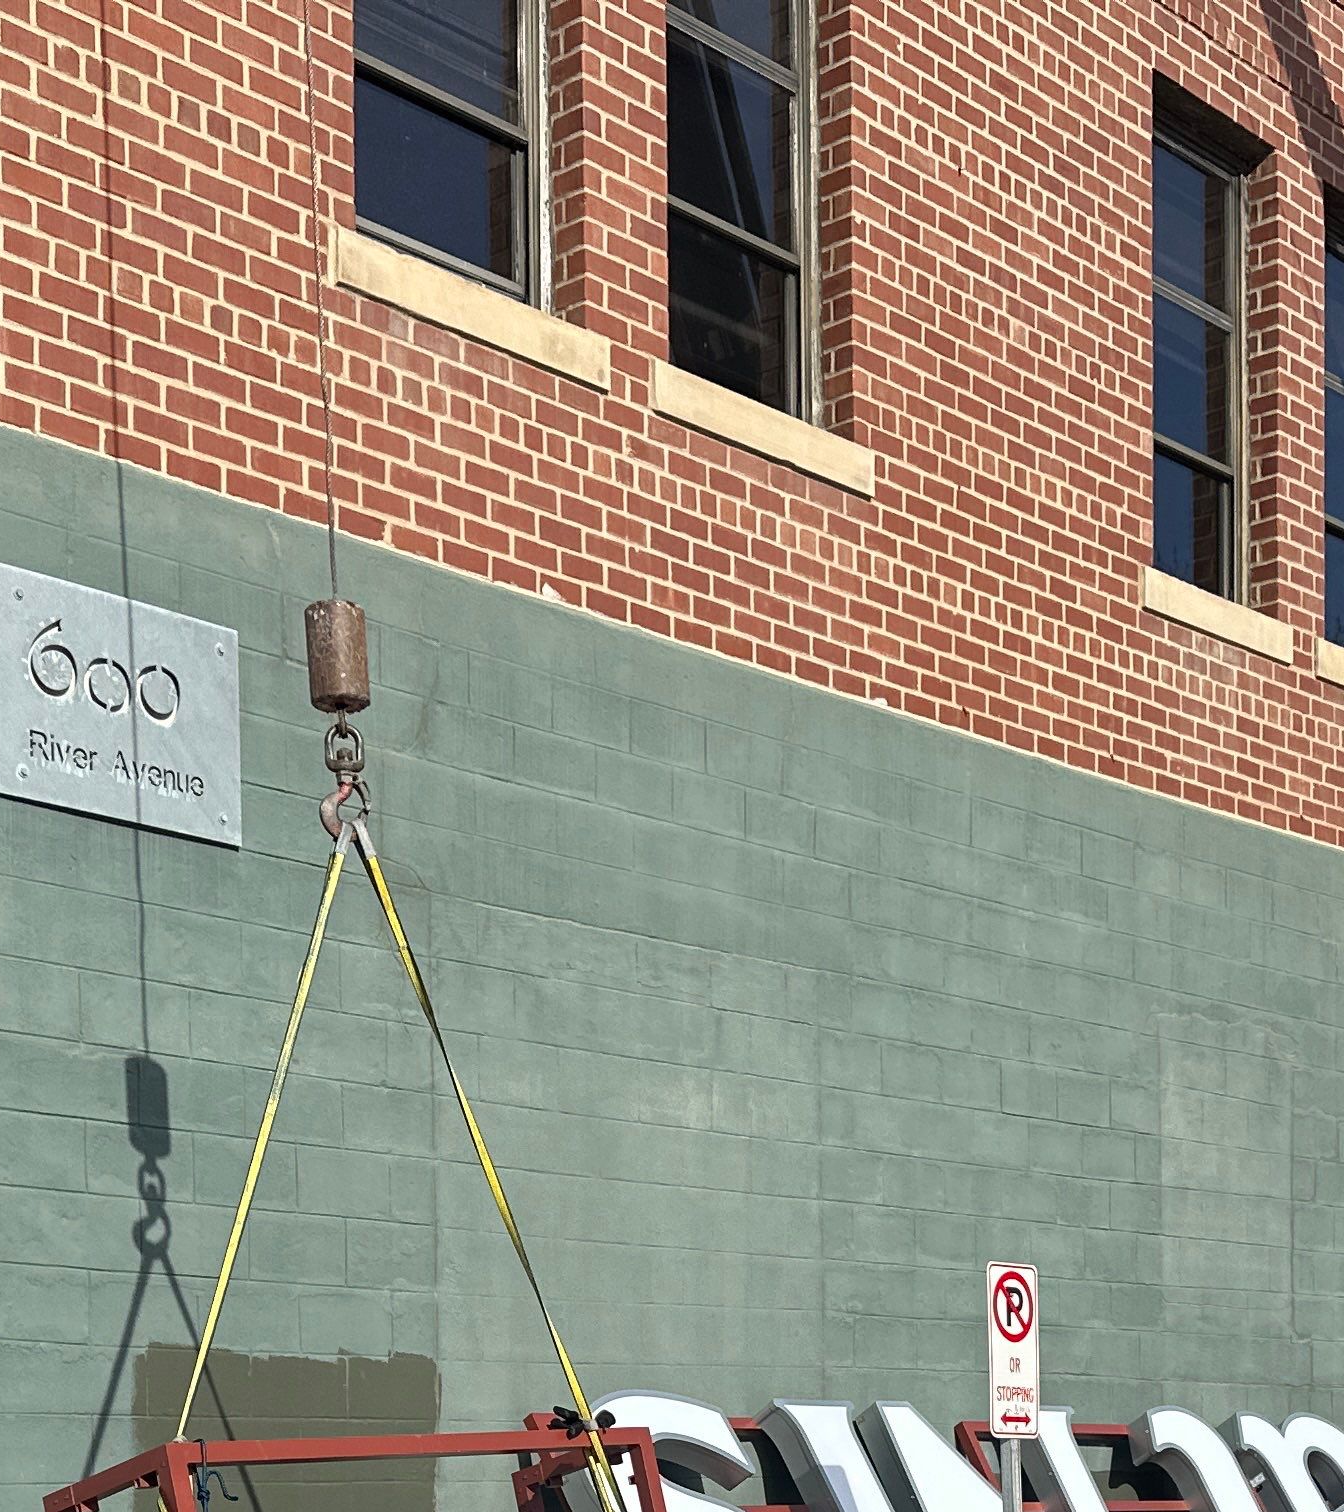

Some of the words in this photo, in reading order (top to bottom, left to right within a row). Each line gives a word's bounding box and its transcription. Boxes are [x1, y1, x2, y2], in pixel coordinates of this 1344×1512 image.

[27, 618, 181, 727] 600
[28, 729, 98, 772] River
[112, 749, 205, 798] Avenue
[1009, 1356, 1021, 1373] OR
[996, 1385, 1034, 1403] STOPPING
